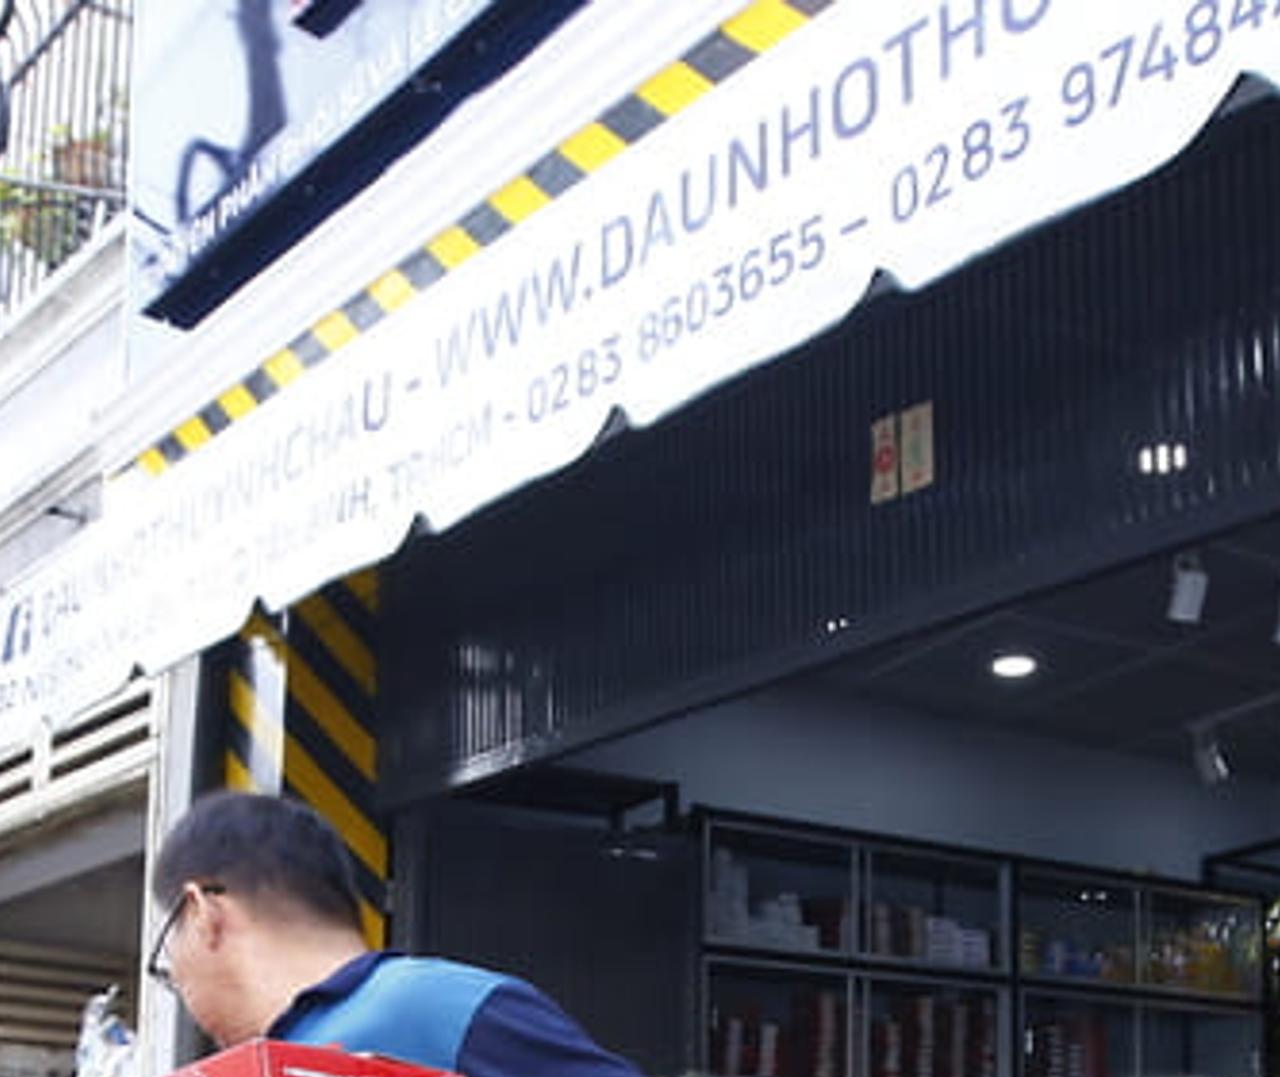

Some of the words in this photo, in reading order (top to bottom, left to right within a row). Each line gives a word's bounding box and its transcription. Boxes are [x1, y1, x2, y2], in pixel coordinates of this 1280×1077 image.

[528, 333, 622, 425] 0283
[637, 214, 827, 363] 8603655
[890, 96, 1031, 225] 0283
